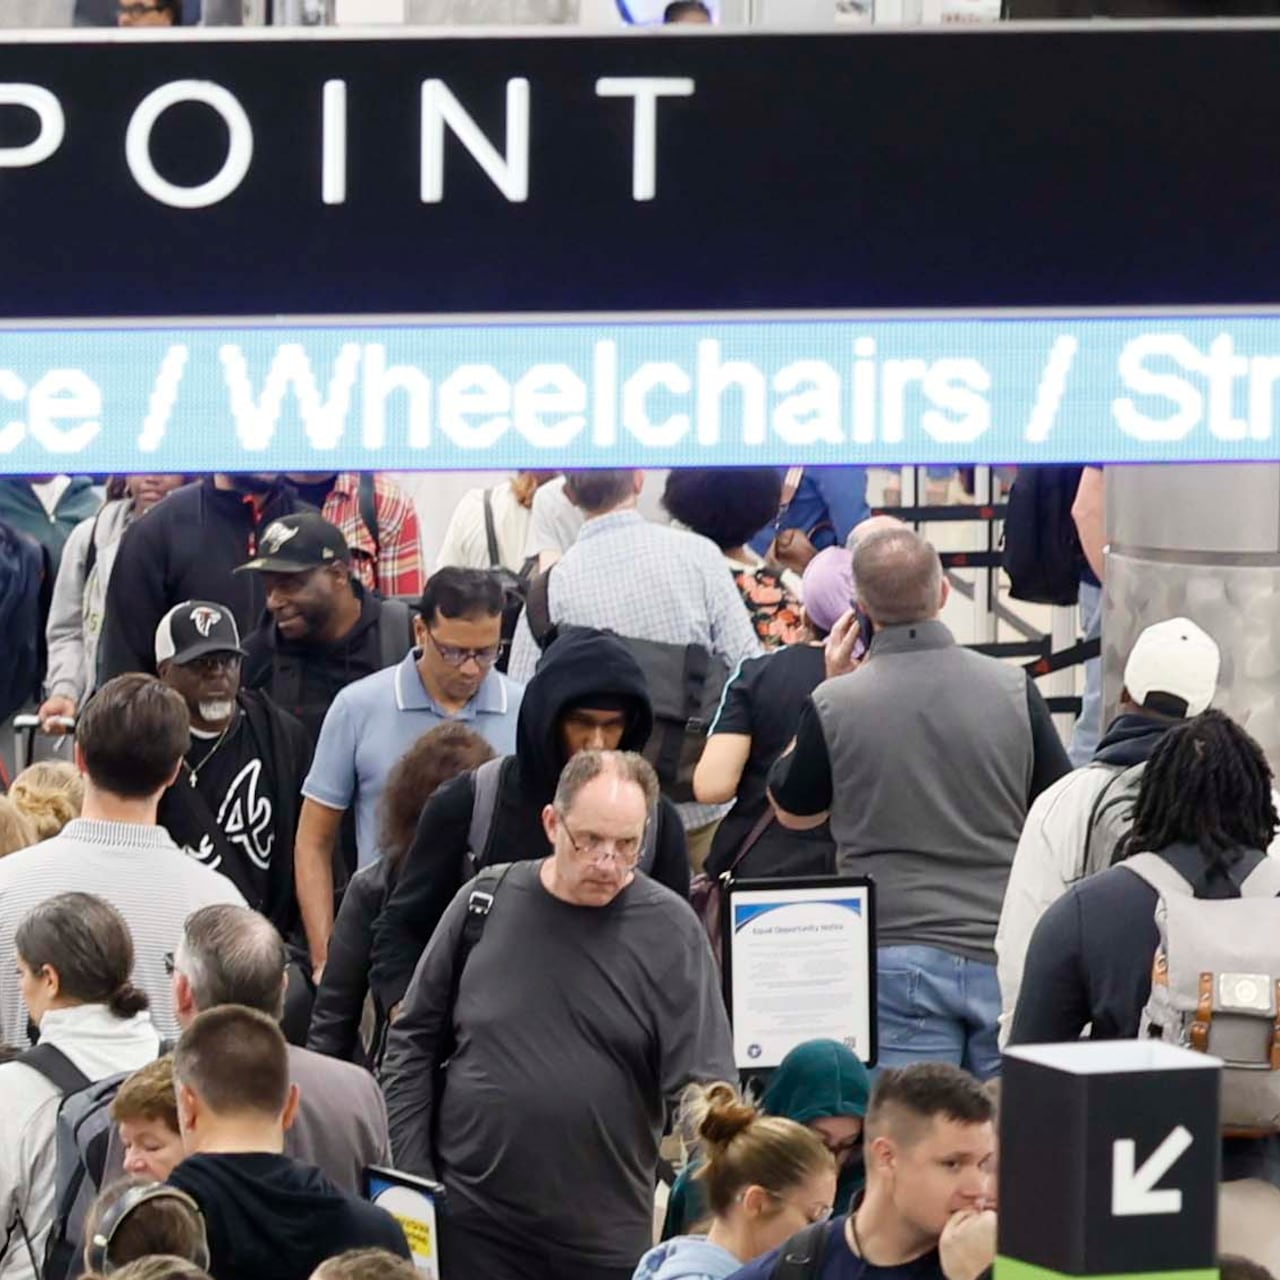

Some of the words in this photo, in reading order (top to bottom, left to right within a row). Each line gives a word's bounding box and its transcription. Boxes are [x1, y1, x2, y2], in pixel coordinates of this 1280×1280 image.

[137, 343, 188, 452] /
[219, 337, 992, 452] Wheelchairs
[1024, 334, 1078, 443] /
